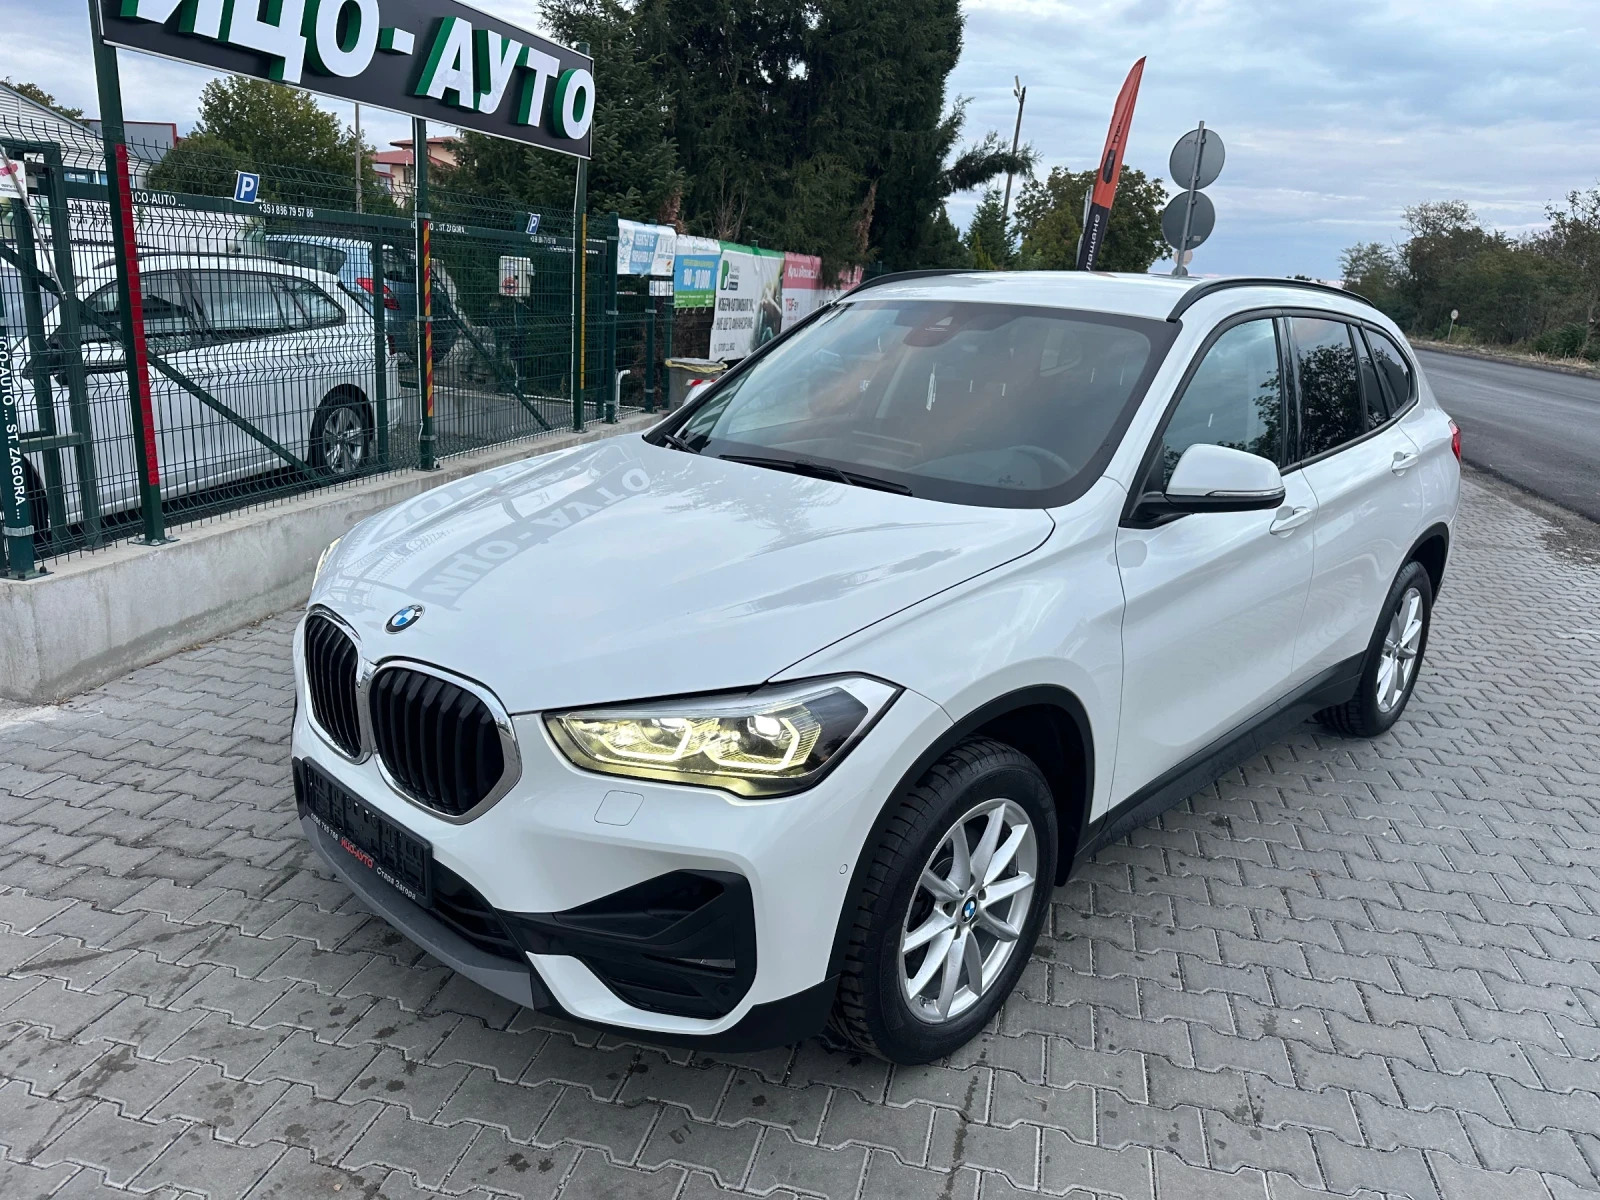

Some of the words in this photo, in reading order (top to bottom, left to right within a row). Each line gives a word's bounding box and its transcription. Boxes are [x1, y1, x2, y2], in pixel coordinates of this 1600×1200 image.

[240, 177, 254, 198] P
[298, 207, 305, 217] 57
[530, 216, 539, 232] P
[6, 424, 19, 444] ST.
[9, 447, 26, 506] ZAGORA
[376, 866, 395, 885] Стара
[395, 880, 416, 900] Загора
